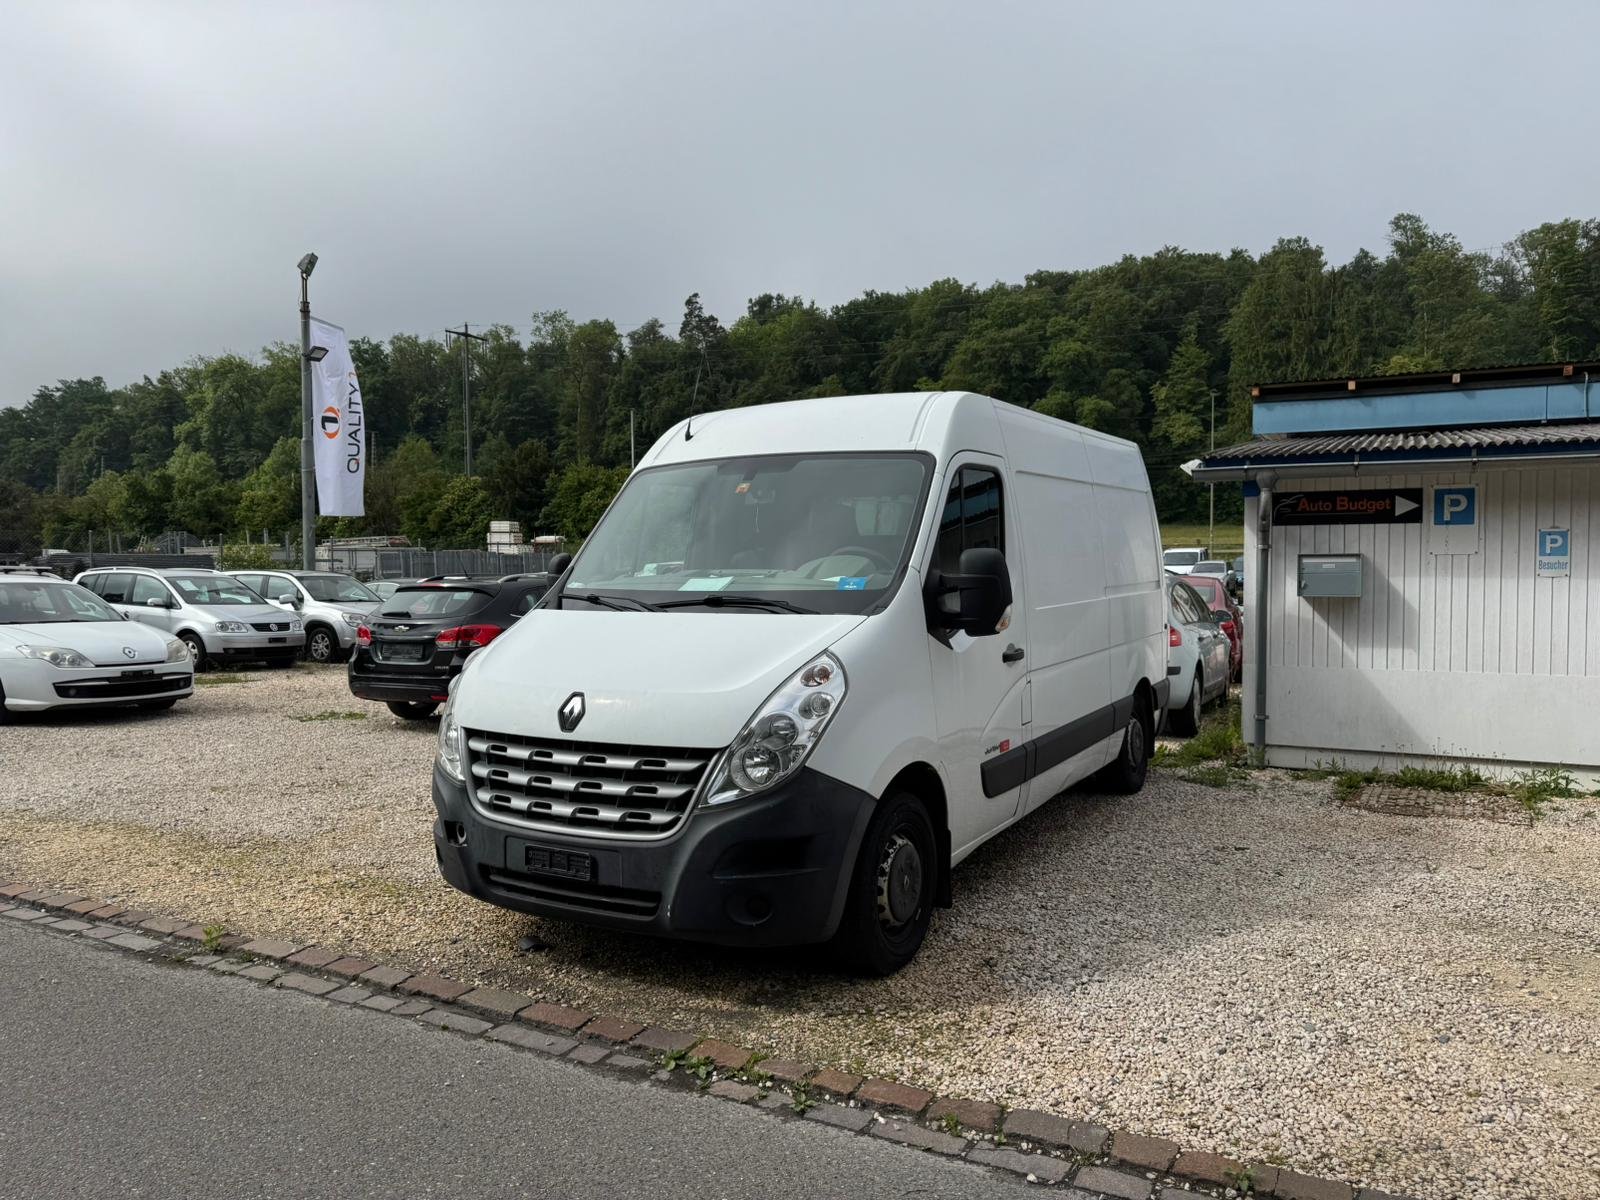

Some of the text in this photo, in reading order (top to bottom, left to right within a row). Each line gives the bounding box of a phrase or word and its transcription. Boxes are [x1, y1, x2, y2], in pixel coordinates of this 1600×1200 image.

[1296, 495, 1391, 513] Auto Budget
[1443, 494, 1468, 521] P
[1545, 534, 1564, 554] P
[1538, 559, 1569, 570] Besucher
